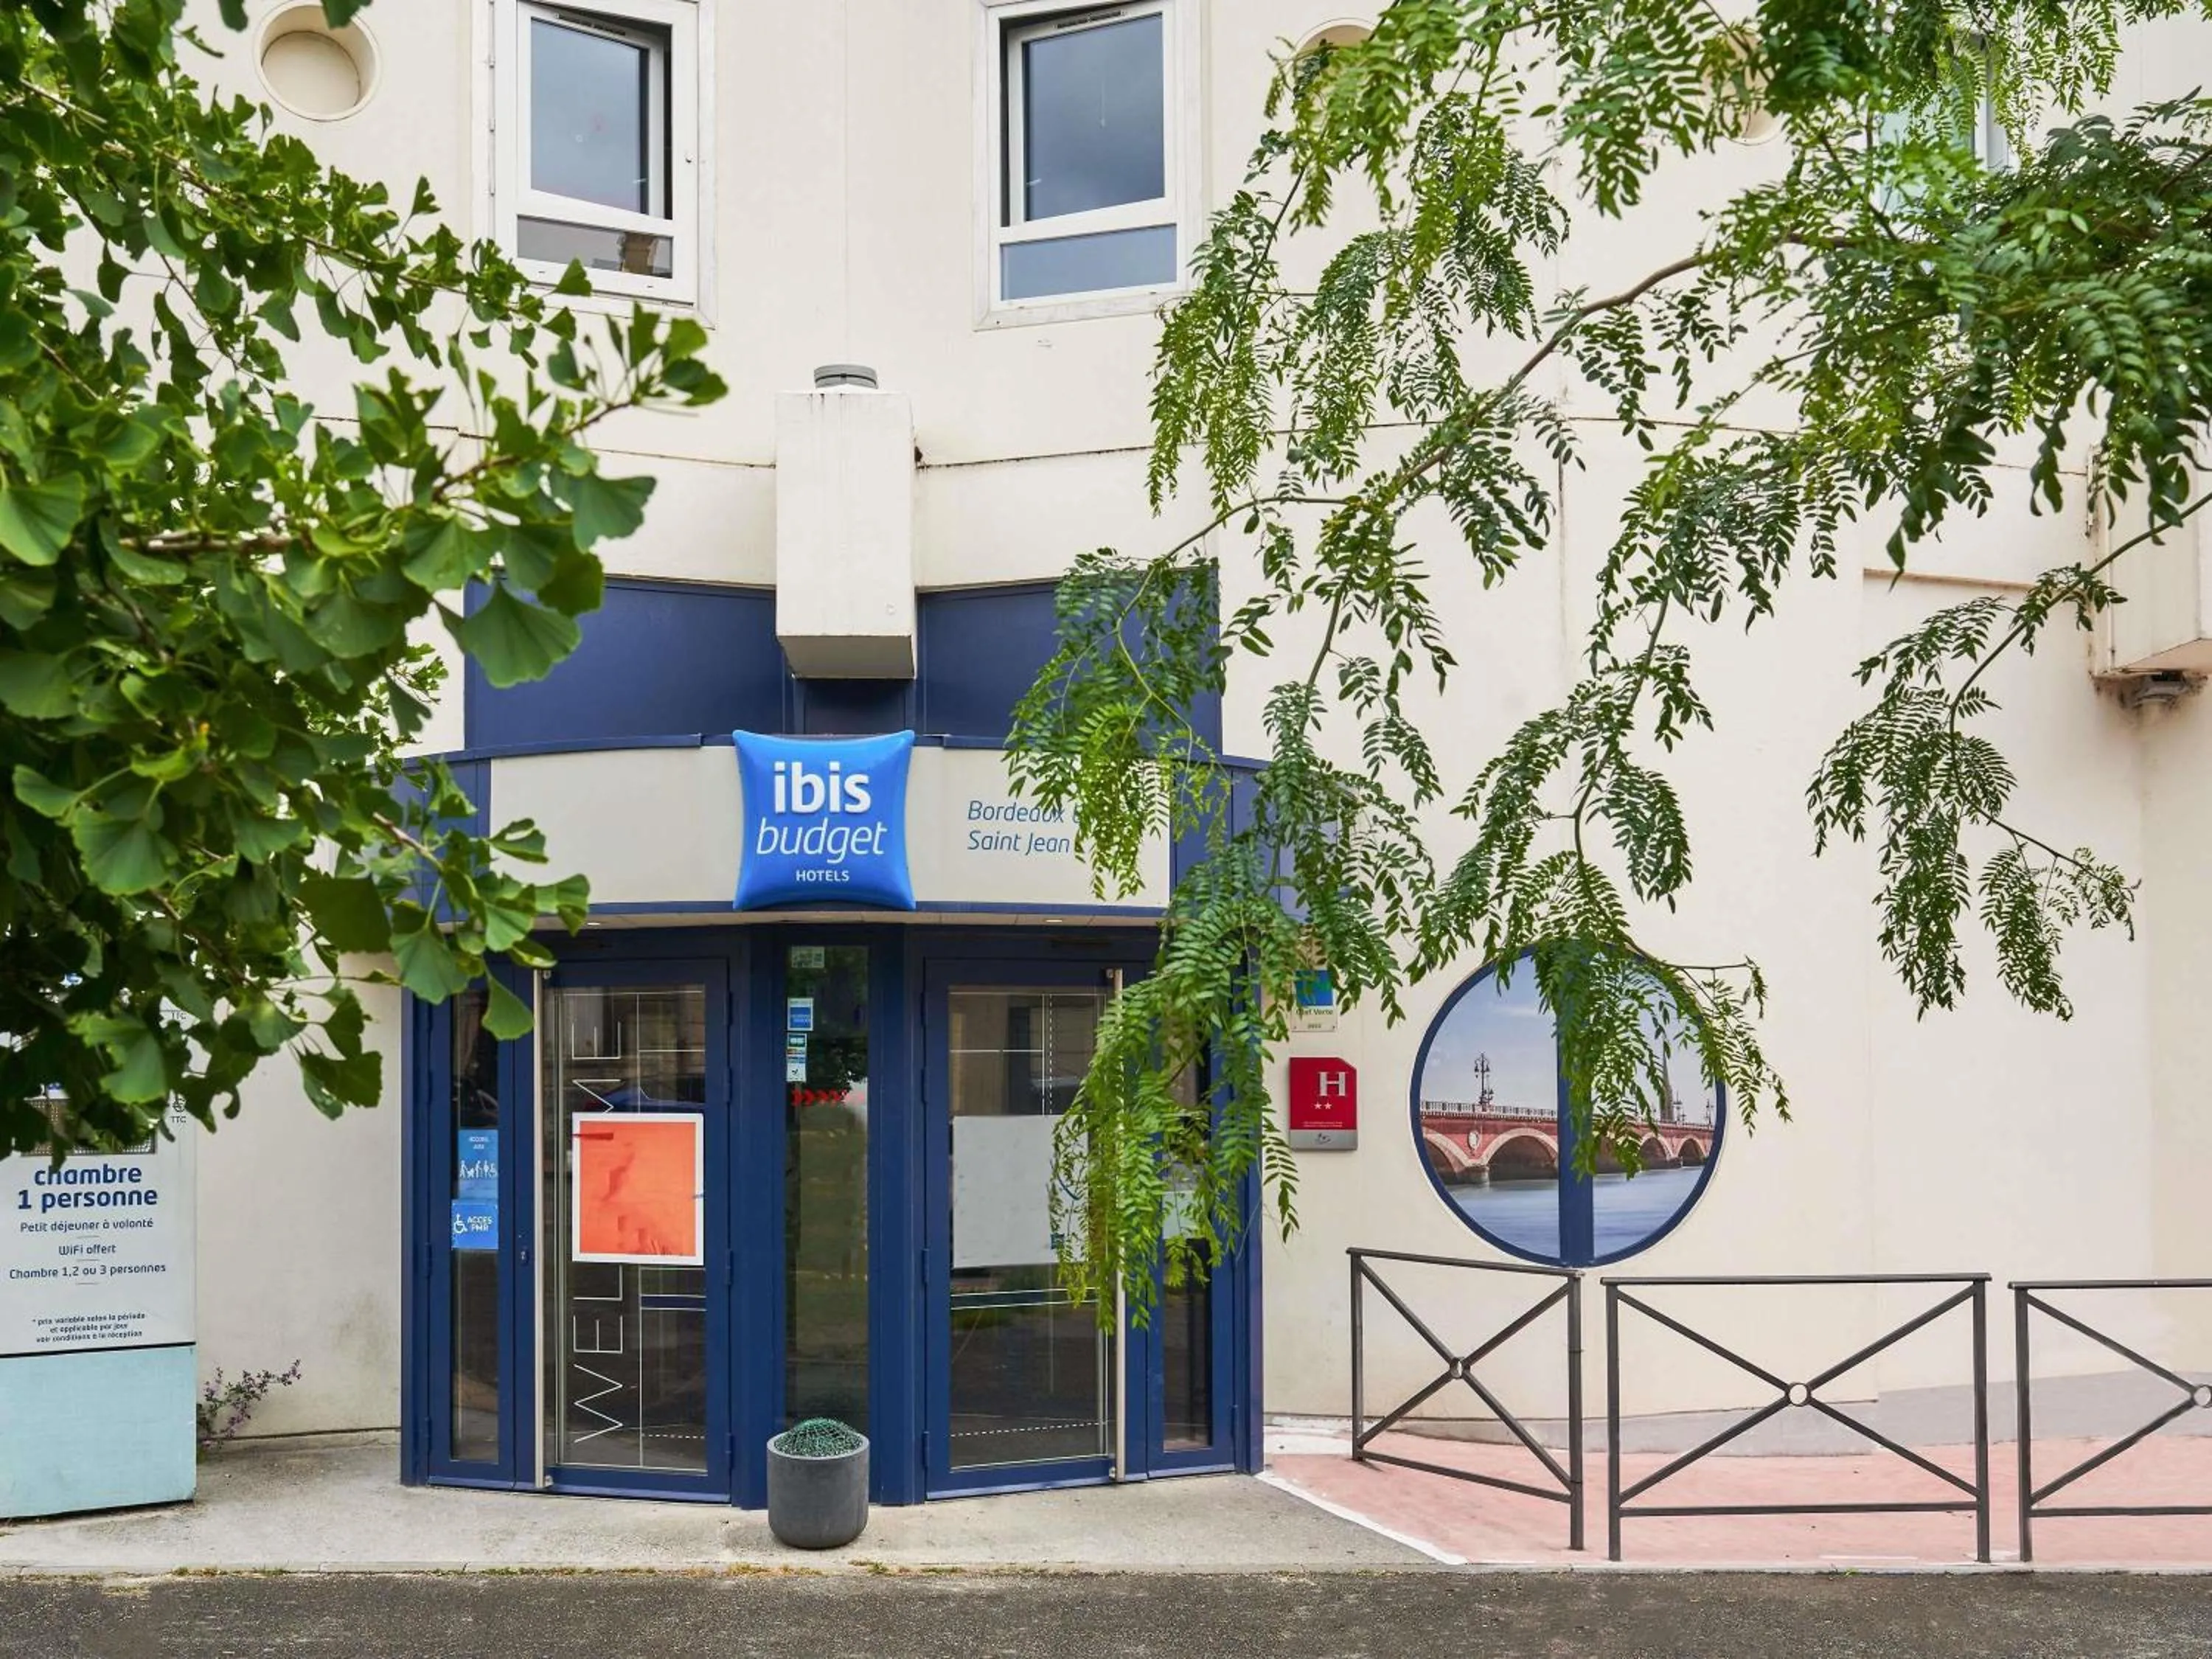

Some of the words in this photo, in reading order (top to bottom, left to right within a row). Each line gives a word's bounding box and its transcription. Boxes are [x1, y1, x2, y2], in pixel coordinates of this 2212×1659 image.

[774, 761, 872, 813] ibis
[967, 800, 1065, 823] Bordeaux
[756, 816, 888, 864] budget
[967, 830, 1020, 852] Saint
[1024, 832, 1070, 855] Jean
[795, 869, 850, 882] HOTELS
[1317, 1071, 1348, 1096] H
[34, 1163, 142, 1186] chambre
[18, 1189, 32, 1210] 1
[41, 1189, 158, 1214] personne
[20, 1222, 48, 1232] Petit
[50, 1220, 100, 1233] déjeuner
[102, 1219, 111, 1229] à
[113, 1217, 154, 1229] volonté
[58, 1245, 84, 1256] WiFi
[86, 1244, 116, 1254] offert
[10, 1267, 58, 1279] Chambre
[83, 1267, 97, 1276] ou
[100, 1265, 107, 1275] 3
[110, 1264, 166, 1276] personnes
